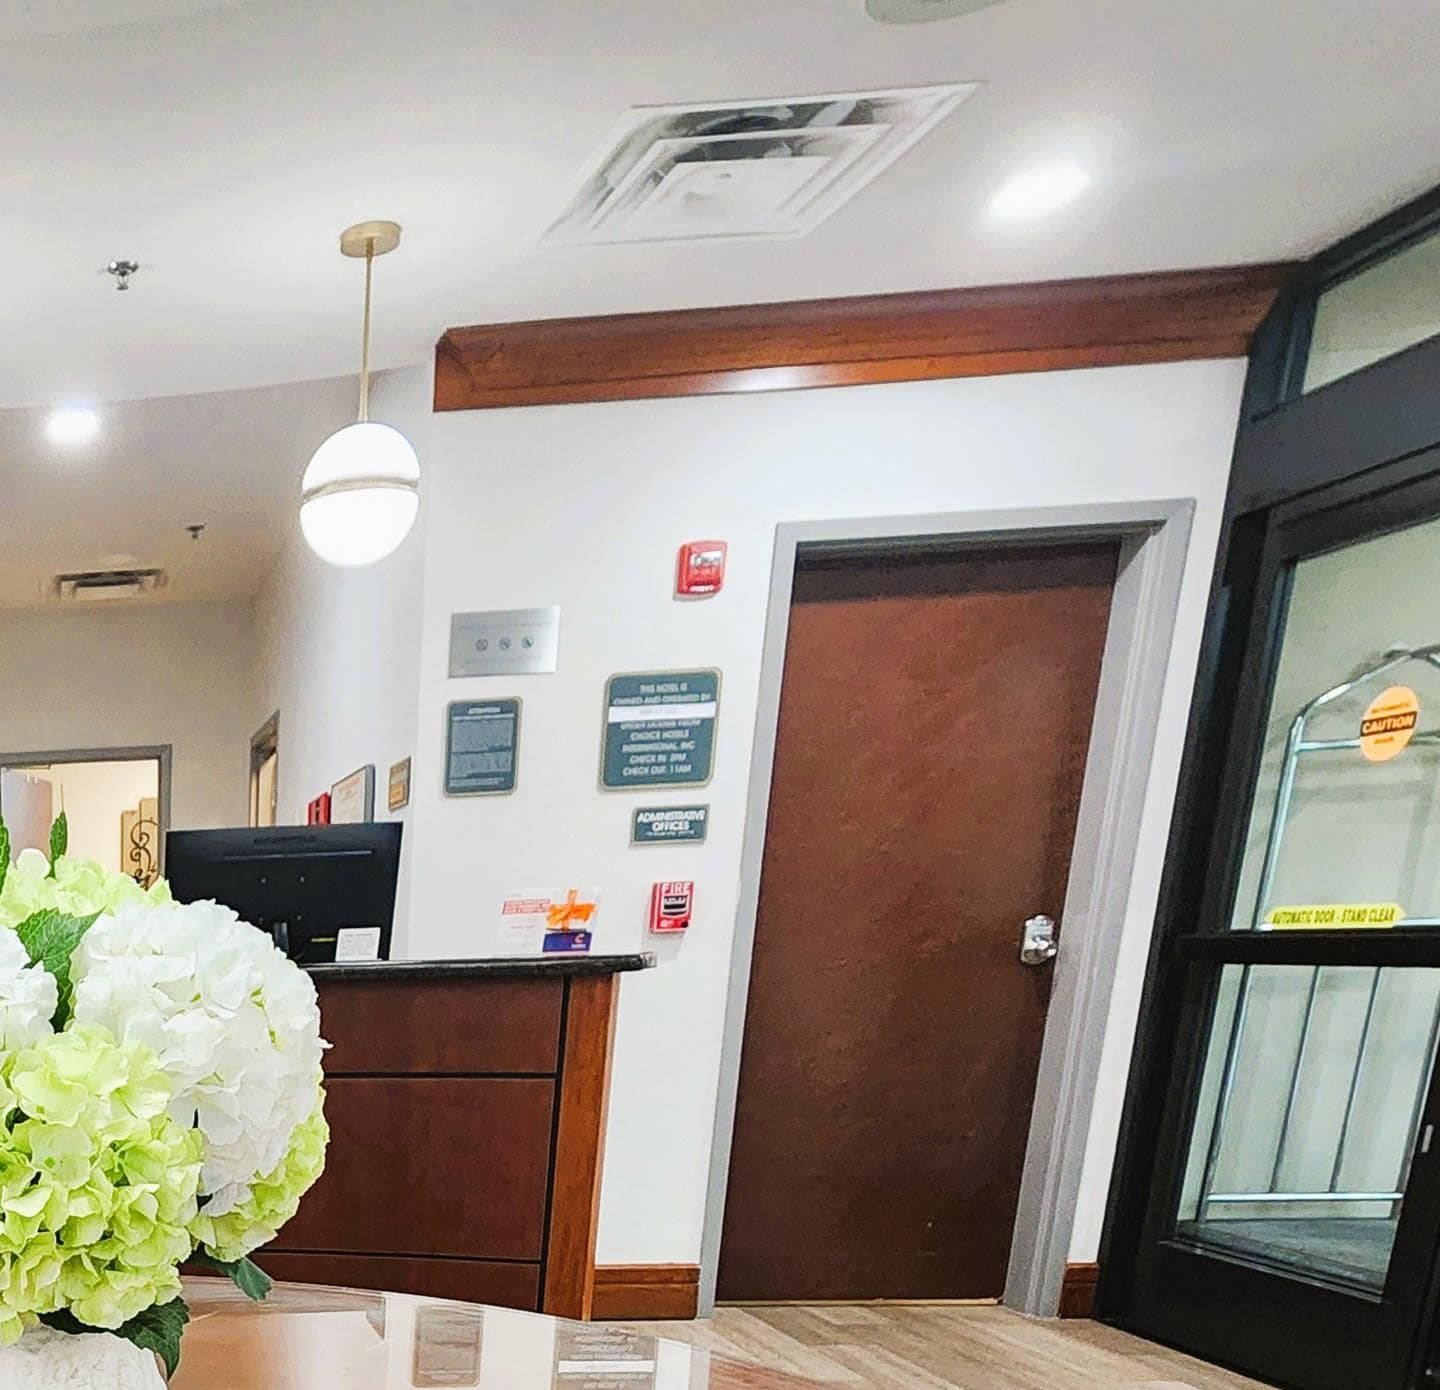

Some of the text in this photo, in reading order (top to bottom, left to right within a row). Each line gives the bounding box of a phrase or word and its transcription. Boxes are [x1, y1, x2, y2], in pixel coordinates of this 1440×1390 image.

[656, 683, 679, 693] HOTEL
[644, 695, 661, 704] AND
[1362, 714, 1415, 734] CAUTION
[622, 766, 649, 776] CHECK
[637, 810, 705, 823] ADMINISTRATIVE
[652, 821, 690, 832] OFFICES
[661, 881, 691, 894] FIRE
[1272, 911, 1313, 924] AUTOMATIC
[1314, 909, 1335, 924] DOOR
[1341, 908, 1367, 922] STAND
[1368, 908, 1396, 922] CLEAR
